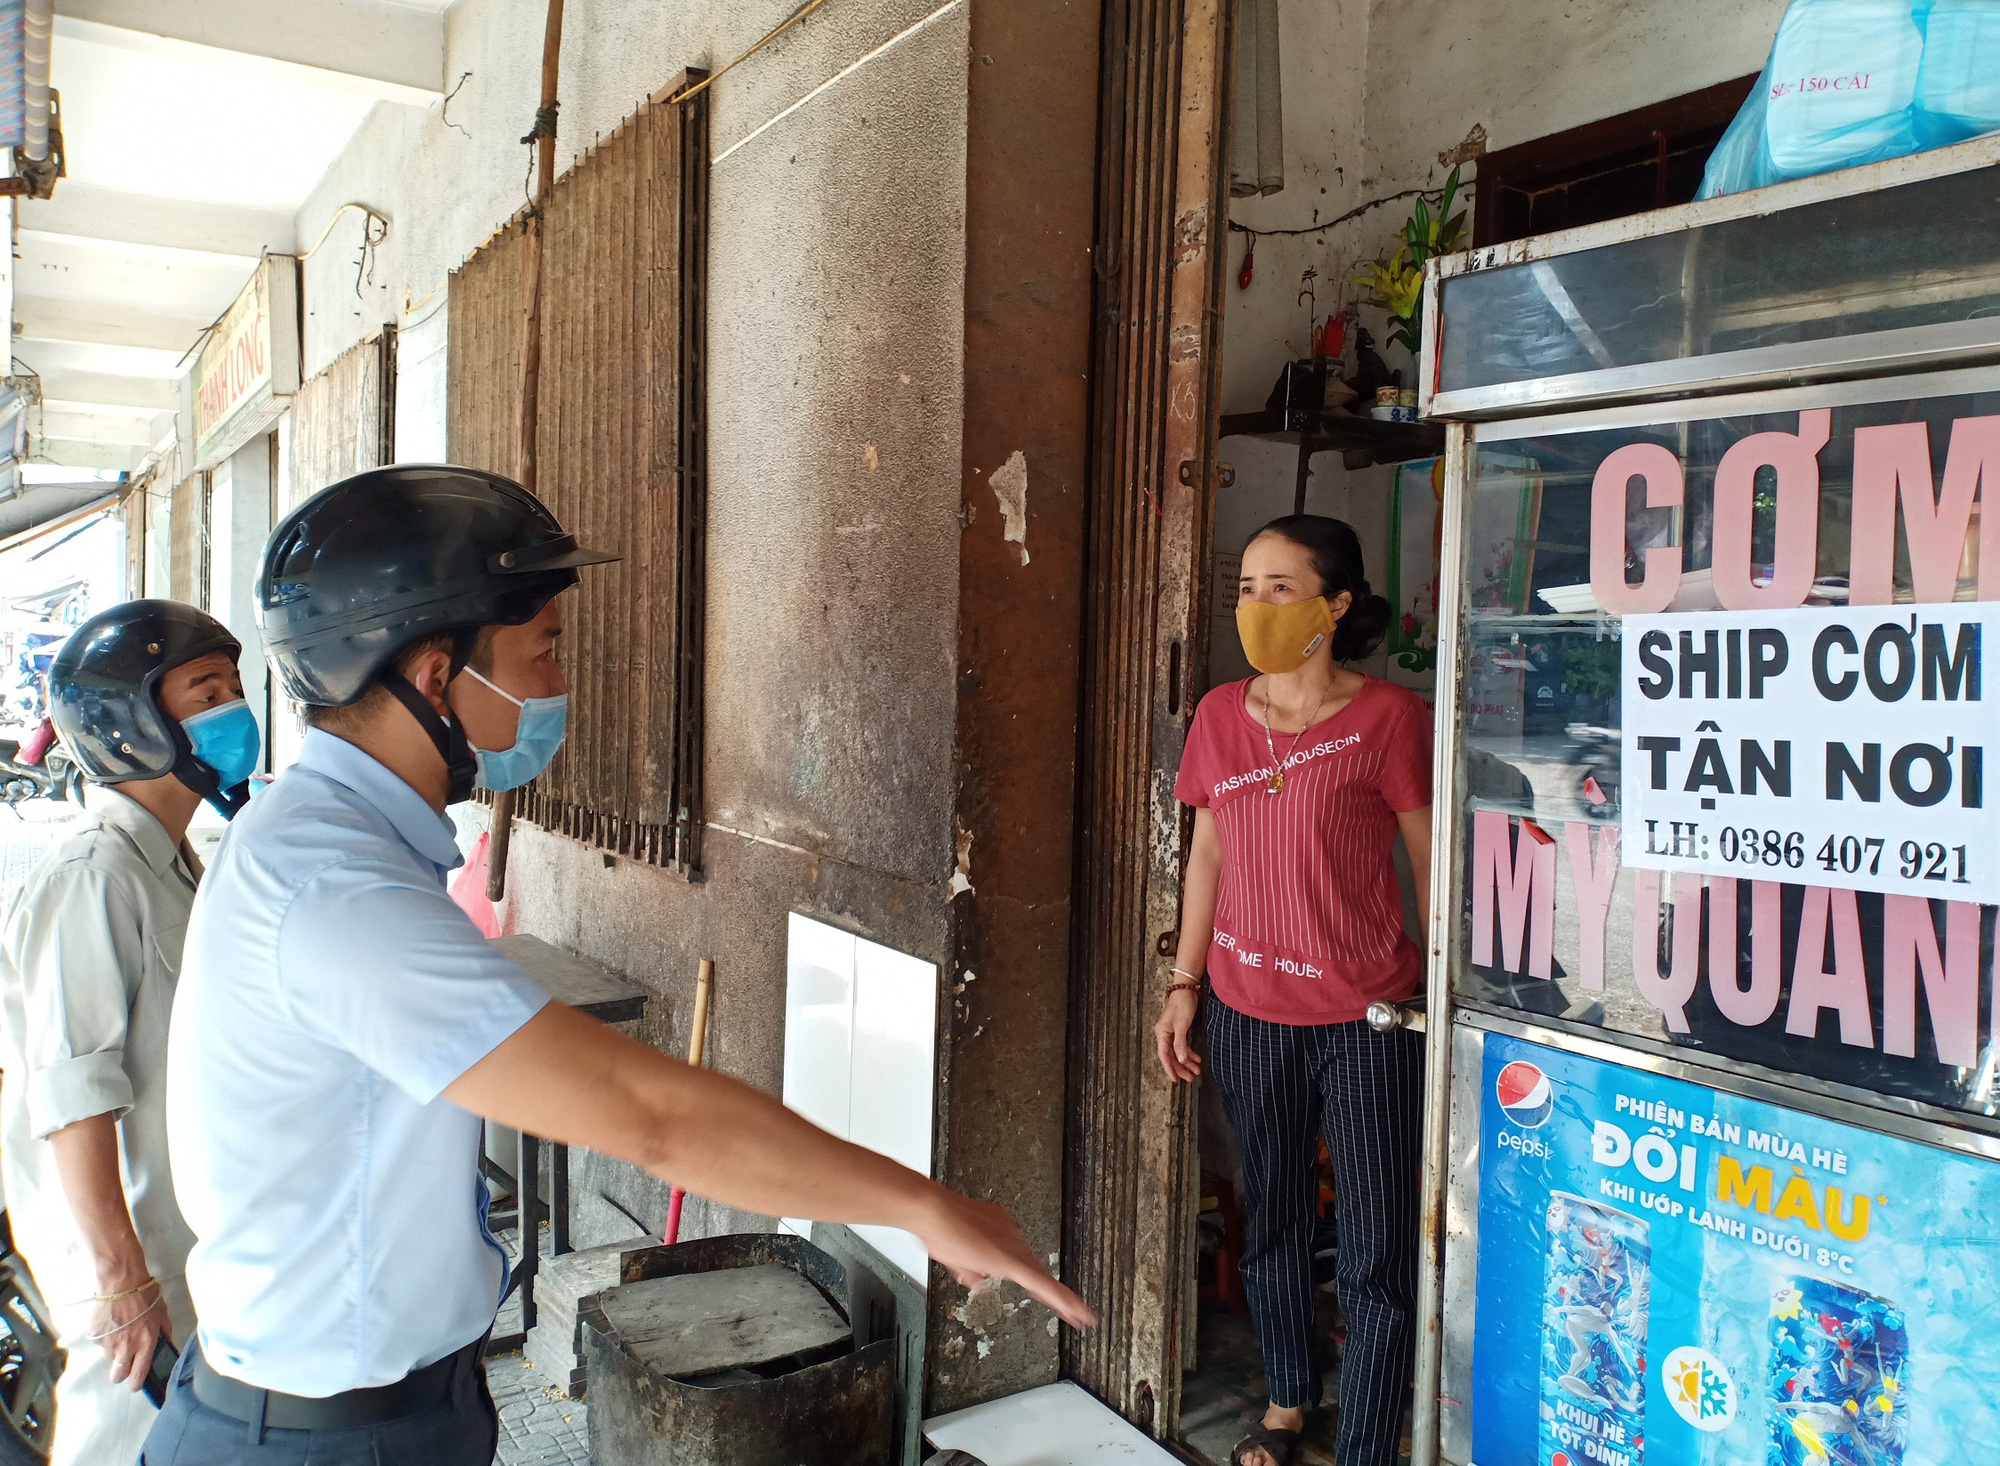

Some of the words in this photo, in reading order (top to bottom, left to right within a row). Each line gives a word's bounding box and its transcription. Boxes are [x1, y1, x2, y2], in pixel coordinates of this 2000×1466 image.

[1799, 76, 1829, 93] 150
[1833, 71, 1872, 92] CÁI
[199, 357, 229, 437] THANH
[230, 311, 264, 403] LONG
[1590, 408, 2000, 615] CƠM
[1637, 628, 1789, 701] SHIP
[1811, 612, 1983, 703] CƠM
[1214, 766, 1275, 797] FASHION
[1282, 732, 1361, 771] MOUSECIN
[1637, 719, 1793, 811] TẬN
[1825, 735, 1984, 810] NƠI
[1644, 819, 1710, 861] LH:
[1718, 825, 1806, 870] 0386
[1815, 834, 1886, 877] 407
[1898, 840, 1972, 885] 921
[1498, 1131, 1550, 1160] pepsi
[1590, 1118, 1698, 1193] ĐỔI
[1615, 1093, 1685, 1129] PHIÊN
[1690, 1111, 1741, 1146] BẢN
[1747, 1131, 1809, 1165] MÙA
[1812, 1146, 1848, 1176] HÈ
[1600, 1178, 1635, 1203] KHI
[1640, 1191, 1685, 1218] ƯỚP
[1688, 1206, 1747, 1240] LẠNH
[1752, 1225, 1811, 1261] DƯỚI
[1549, 1420, 1583, 1451] TỘT
[1583, 1438, 1631, 1466] ĐỈNH
[1556, 1399, 1600, 1434] KHUI
[1602, 1420, 1626, 1446] HÈ
